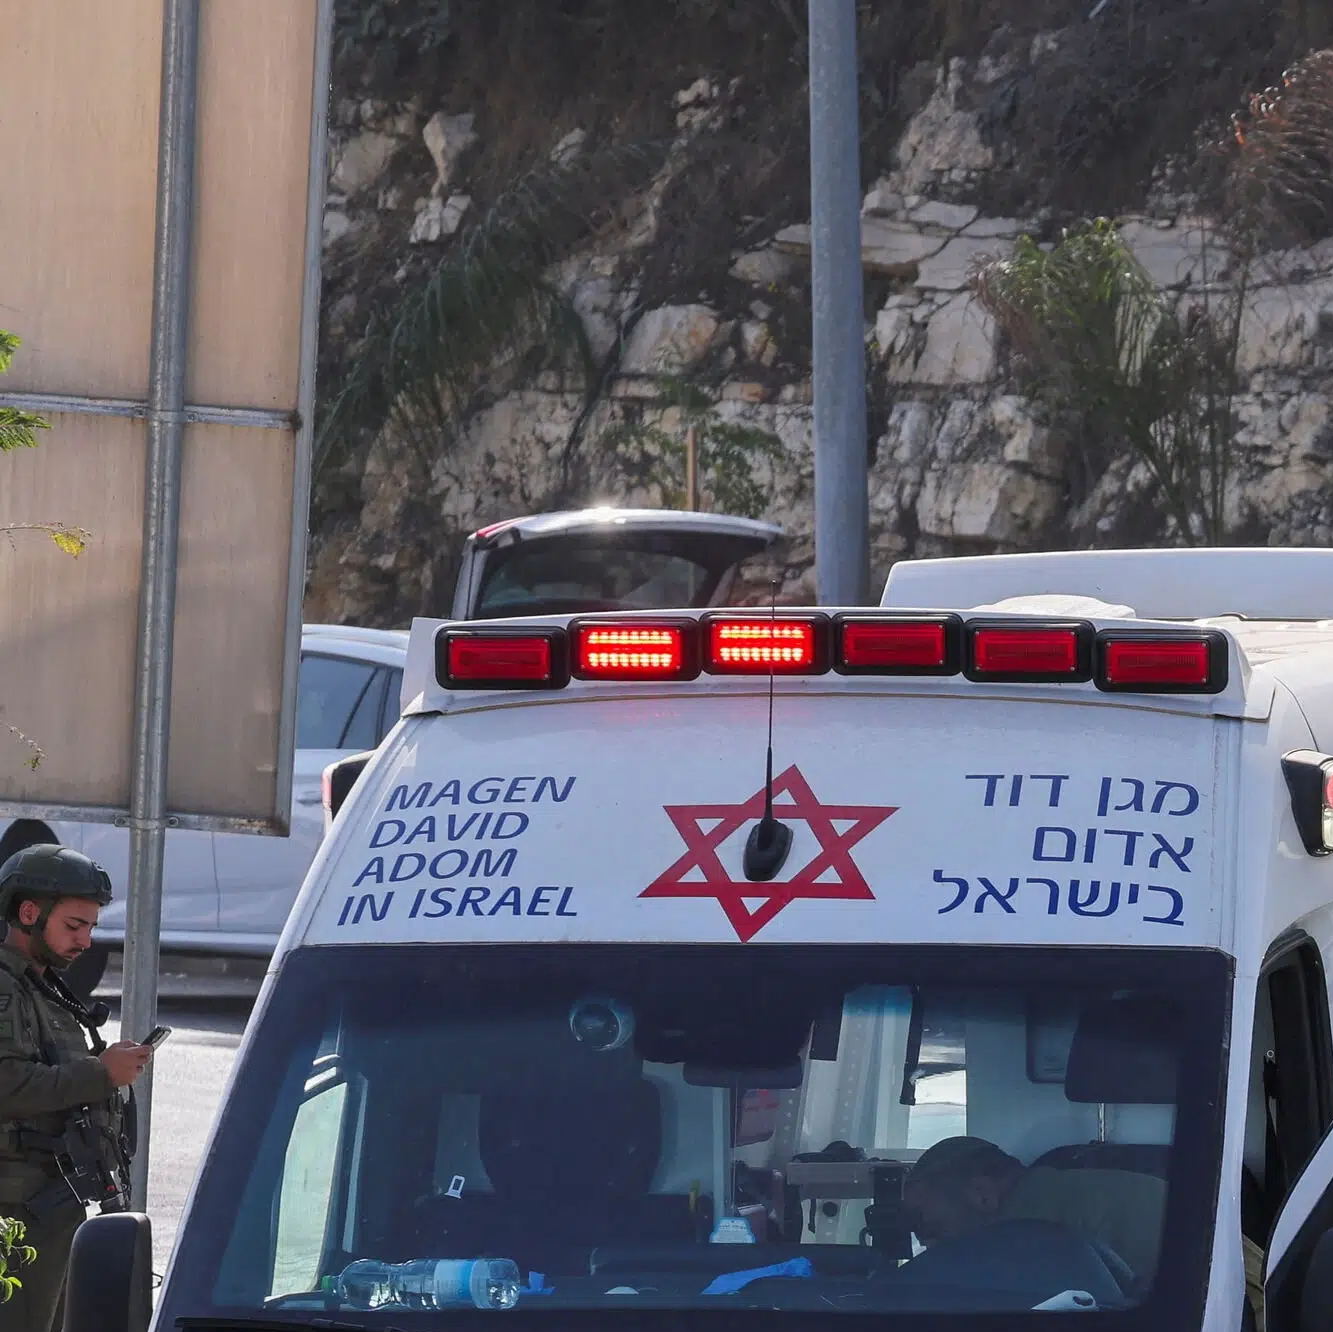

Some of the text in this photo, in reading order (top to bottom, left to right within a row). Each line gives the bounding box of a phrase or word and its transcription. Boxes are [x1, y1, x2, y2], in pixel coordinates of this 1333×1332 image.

[384, 776, 577, 812] MAGEN
[965, 774, 1200, 817] מגן דוד
[369, 811, 530, 848] DAVID
[1032, 826, 1195, 873] אדום
[352, 848, 518, 887] ADOM
[337, 886, 578, 926] IN ISRAEL
[932, 869, 1185, 926] בישראל
